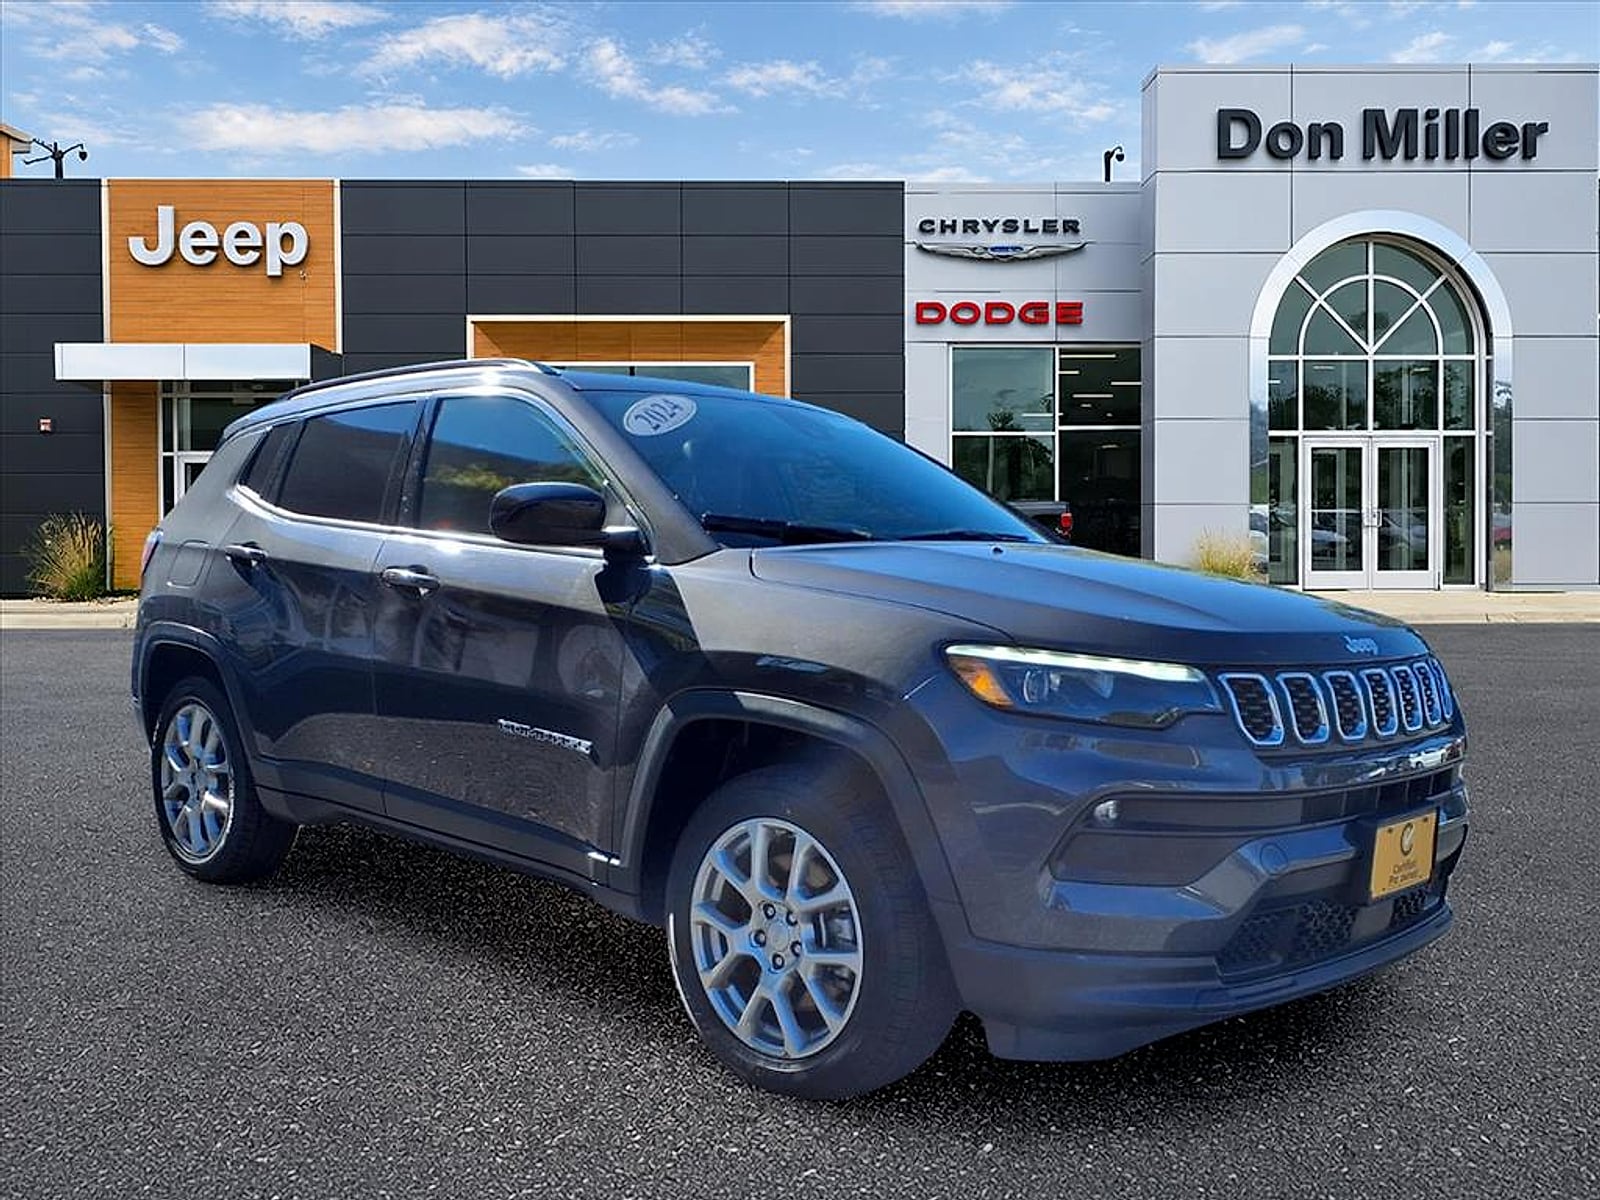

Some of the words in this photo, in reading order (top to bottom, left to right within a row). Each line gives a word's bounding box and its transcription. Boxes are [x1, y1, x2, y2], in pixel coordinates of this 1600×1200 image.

[1217, 108, 1344, 160] Don
[1363, 108, 1549, 160] Miller
[128, 205, 309, 277] Jeep
[918, 218, 1081, 235] CHRYSLER
[915, 301, 1084, 326] DODGE
[634, 398, 684, 431] 2024
[1343, 635, 1378, 656] Jeep
